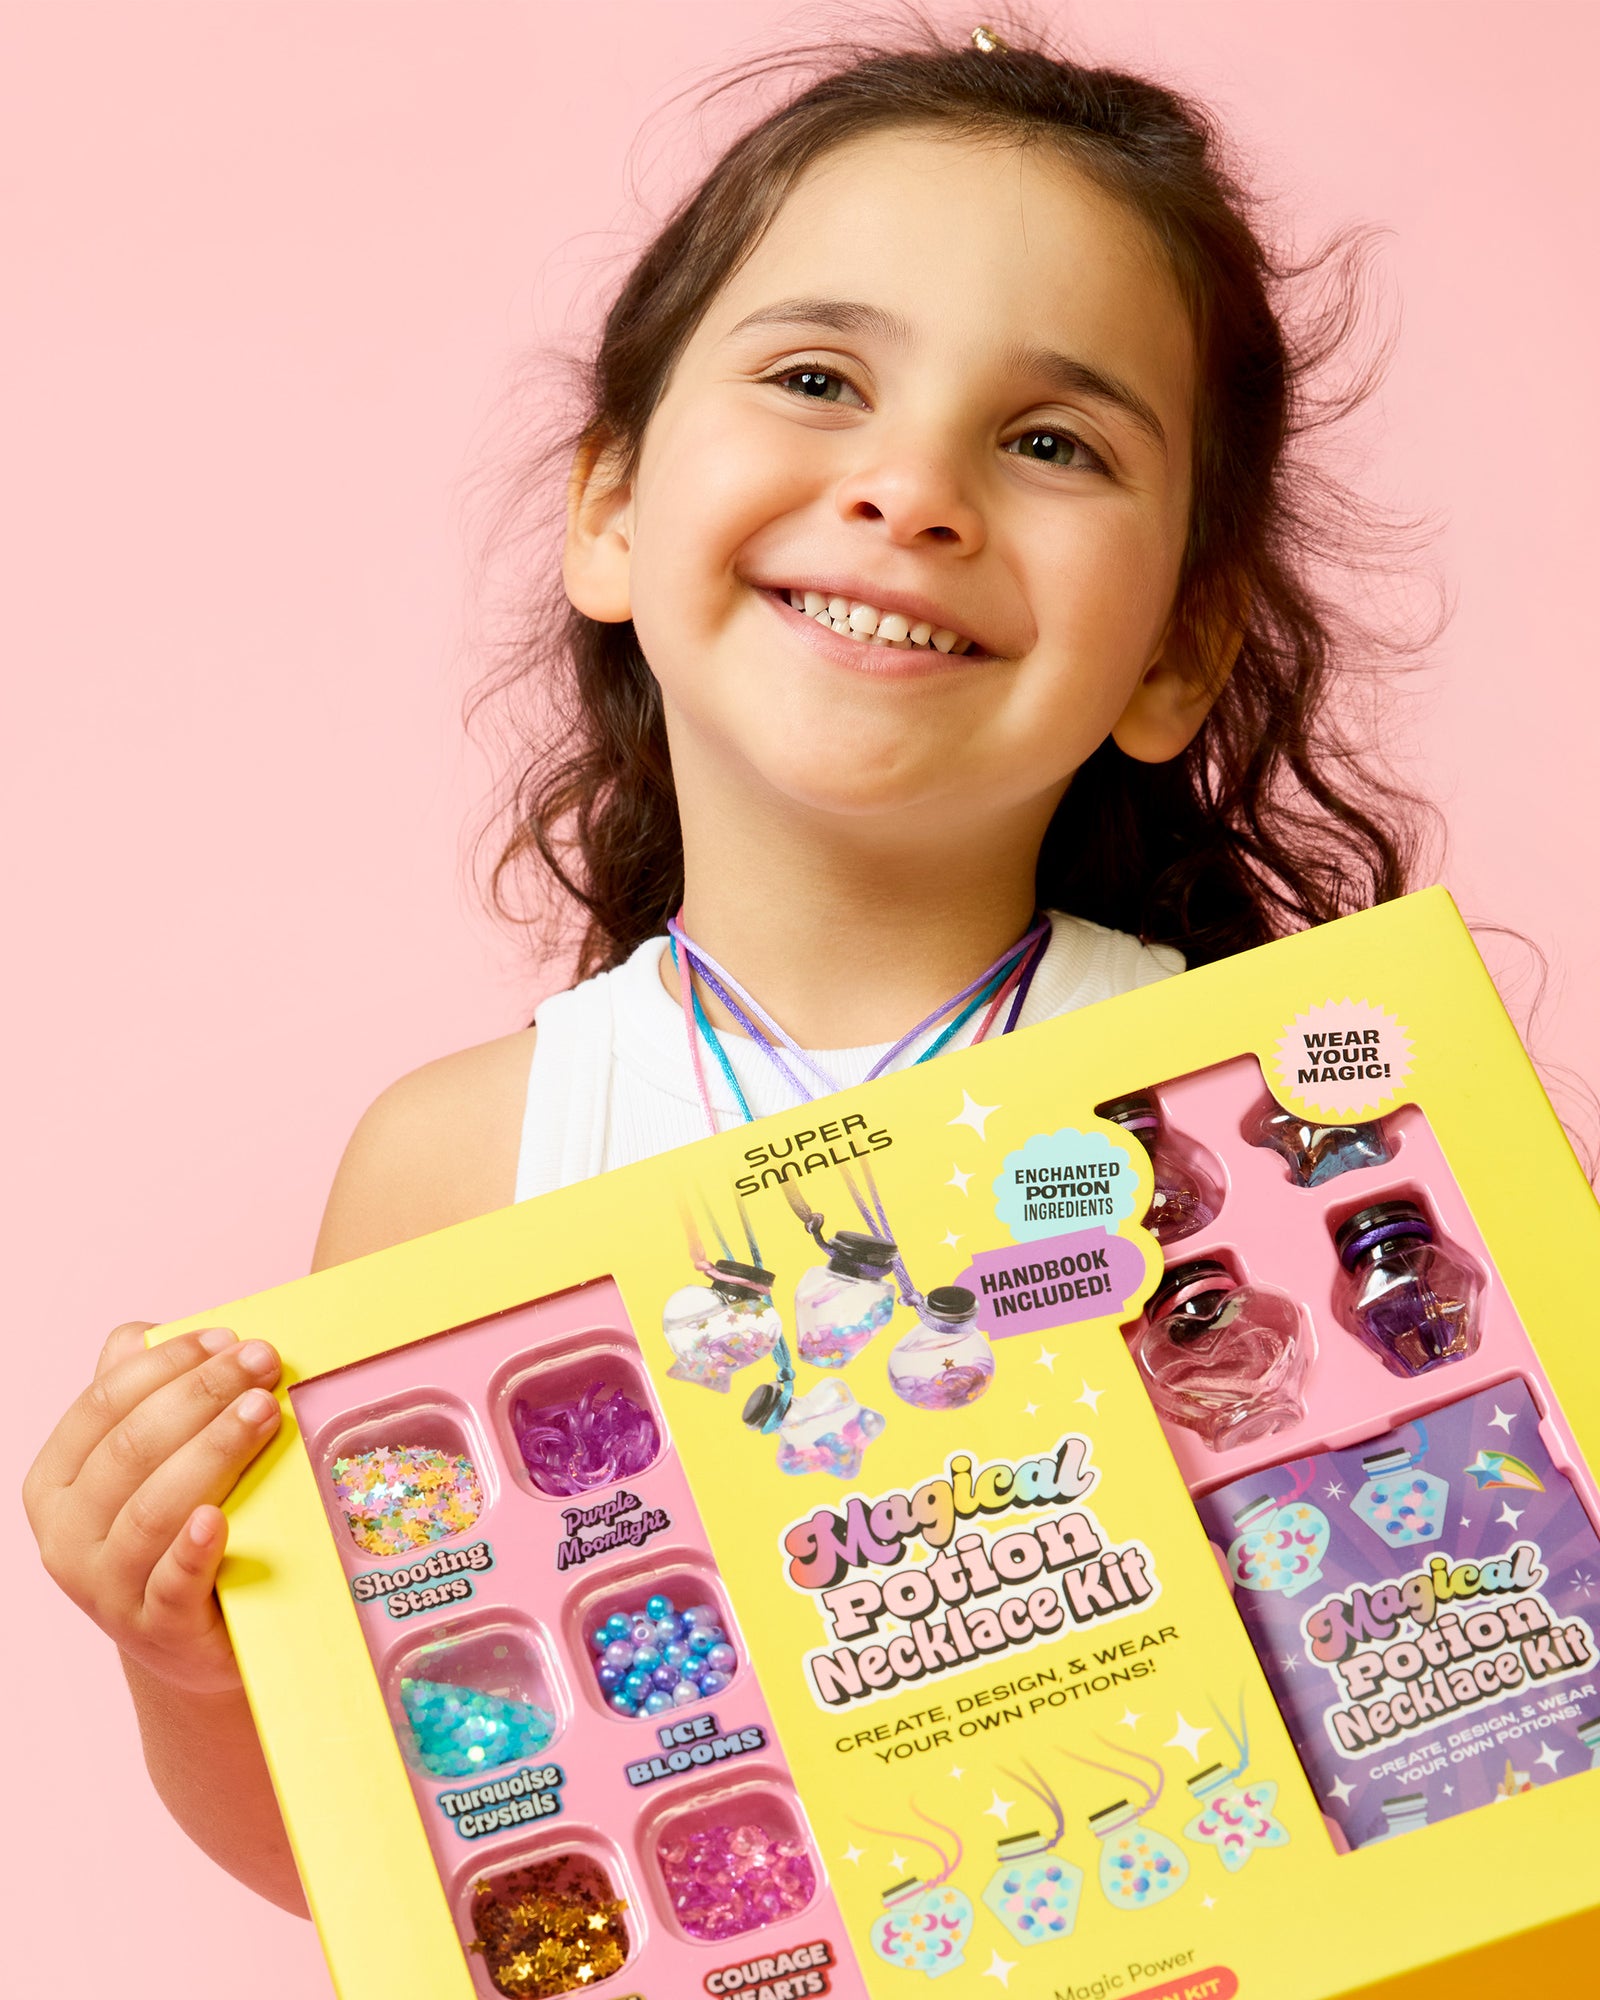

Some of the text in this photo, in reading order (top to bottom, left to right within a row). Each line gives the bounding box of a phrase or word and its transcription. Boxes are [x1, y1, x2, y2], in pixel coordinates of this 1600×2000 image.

[1303, 1029, 1381, 1049] WEAR
[1307, 1047, 1379, 1066] YOUR
[1297, 1063, 1392, 1084] MAGIC!
[734, 1128, 894, 1197] SMALLS
[744, 1113, 868, 1169] SUPER
[1015, 1161, 1120, 1184] ENCHANTED
[1026, 1180, 1110, 1200] POTION
[1023, 1197, 1114, 1222] INGREDIENTS
[979, 1248, 1109, 1295] HANDBOOK
[992, 1273, 1113, 1318] INCLUDED!
[561, 1490, 642, 1537] Purple
[784, 1437, 1096, 1590] Magical
[556, 1509, 671, 1572] Moonlight
[352, 1542, 493, 1601] Shooting
[387, 1577, 473, 1619] Stars
[821, 1511, 1103, 1642] Potion
[810, 1546, 1153, 1706] Necklace Kit
[1306, 1545, 1543, 1663] Magical
[1337, 1597, 1550, 1701] Potion
[835, 1625, 1181, 1753] CREATE, DESIGN, & WEAR
[875, 1658, 1157, 1764] YOUR OWN POTIONS!
[1332, 1623, 1592, 1751] Necklace Kit
[625, 1727, 767, 1787] BLOOMS
[658, 1714, 718, 1750] ICE
[1369, 1684, 1598, 1781] CREATE, DESIGN, & WEAR
[1395, 1703, 1583, 1786] YOUR OWN POTIONS!
[440, 1765, 563, 1818] Turquoise
[458, 1791, 562, 1839] Crystals
[706, 1942, 832, 1995] COURAGE
[722, 1970, 827, 2000] EARTS
[1054, 1949, 1196, 2000] Magic Power
[1184, 1978, 1221, 2000] KIT
